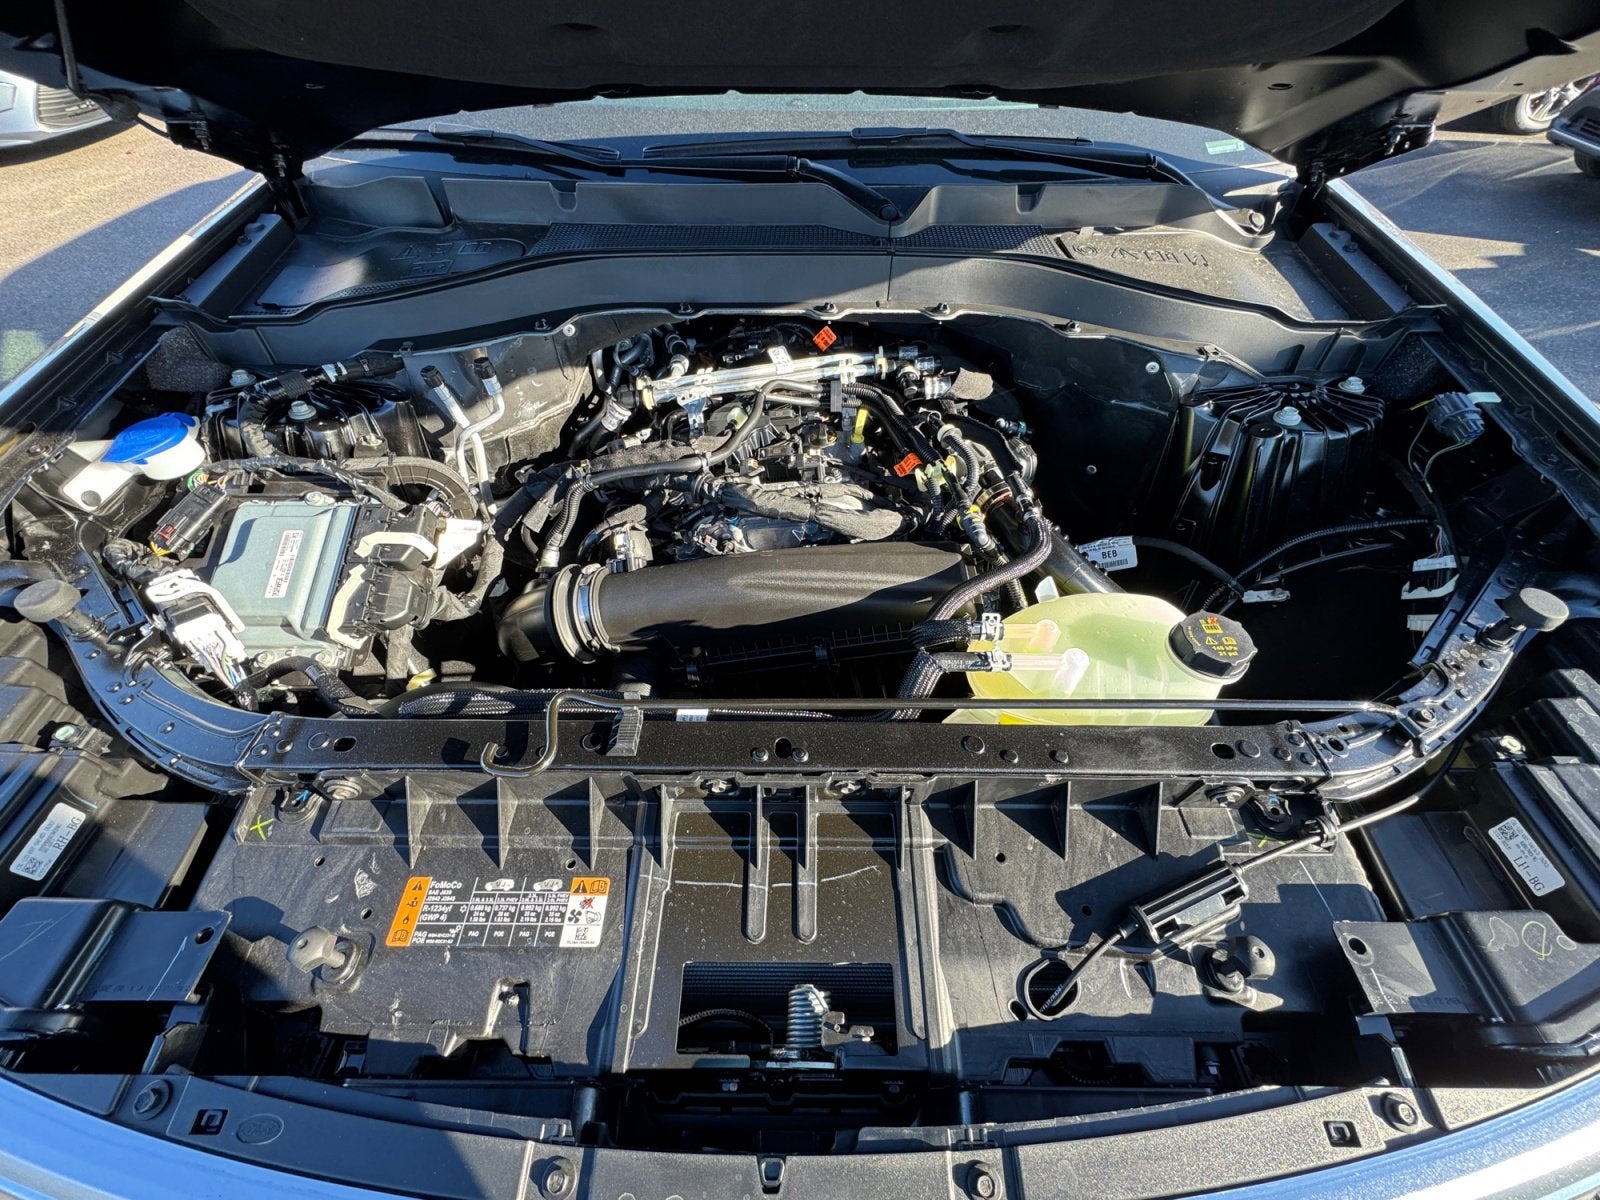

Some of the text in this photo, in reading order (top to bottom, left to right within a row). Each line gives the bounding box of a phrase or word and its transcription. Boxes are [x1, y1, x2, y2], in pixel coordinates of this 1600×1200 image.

[1101, 550, 1118, 559] BEB
[53, 817, 82, 850] RH-BG
[1513, 856, 1545, 891] LH-BG
[430, 881, 463, 889] FoMoCo
[422, 904, 453, 913] R-1234yf
[419, 914, 439, 923] (GWP
